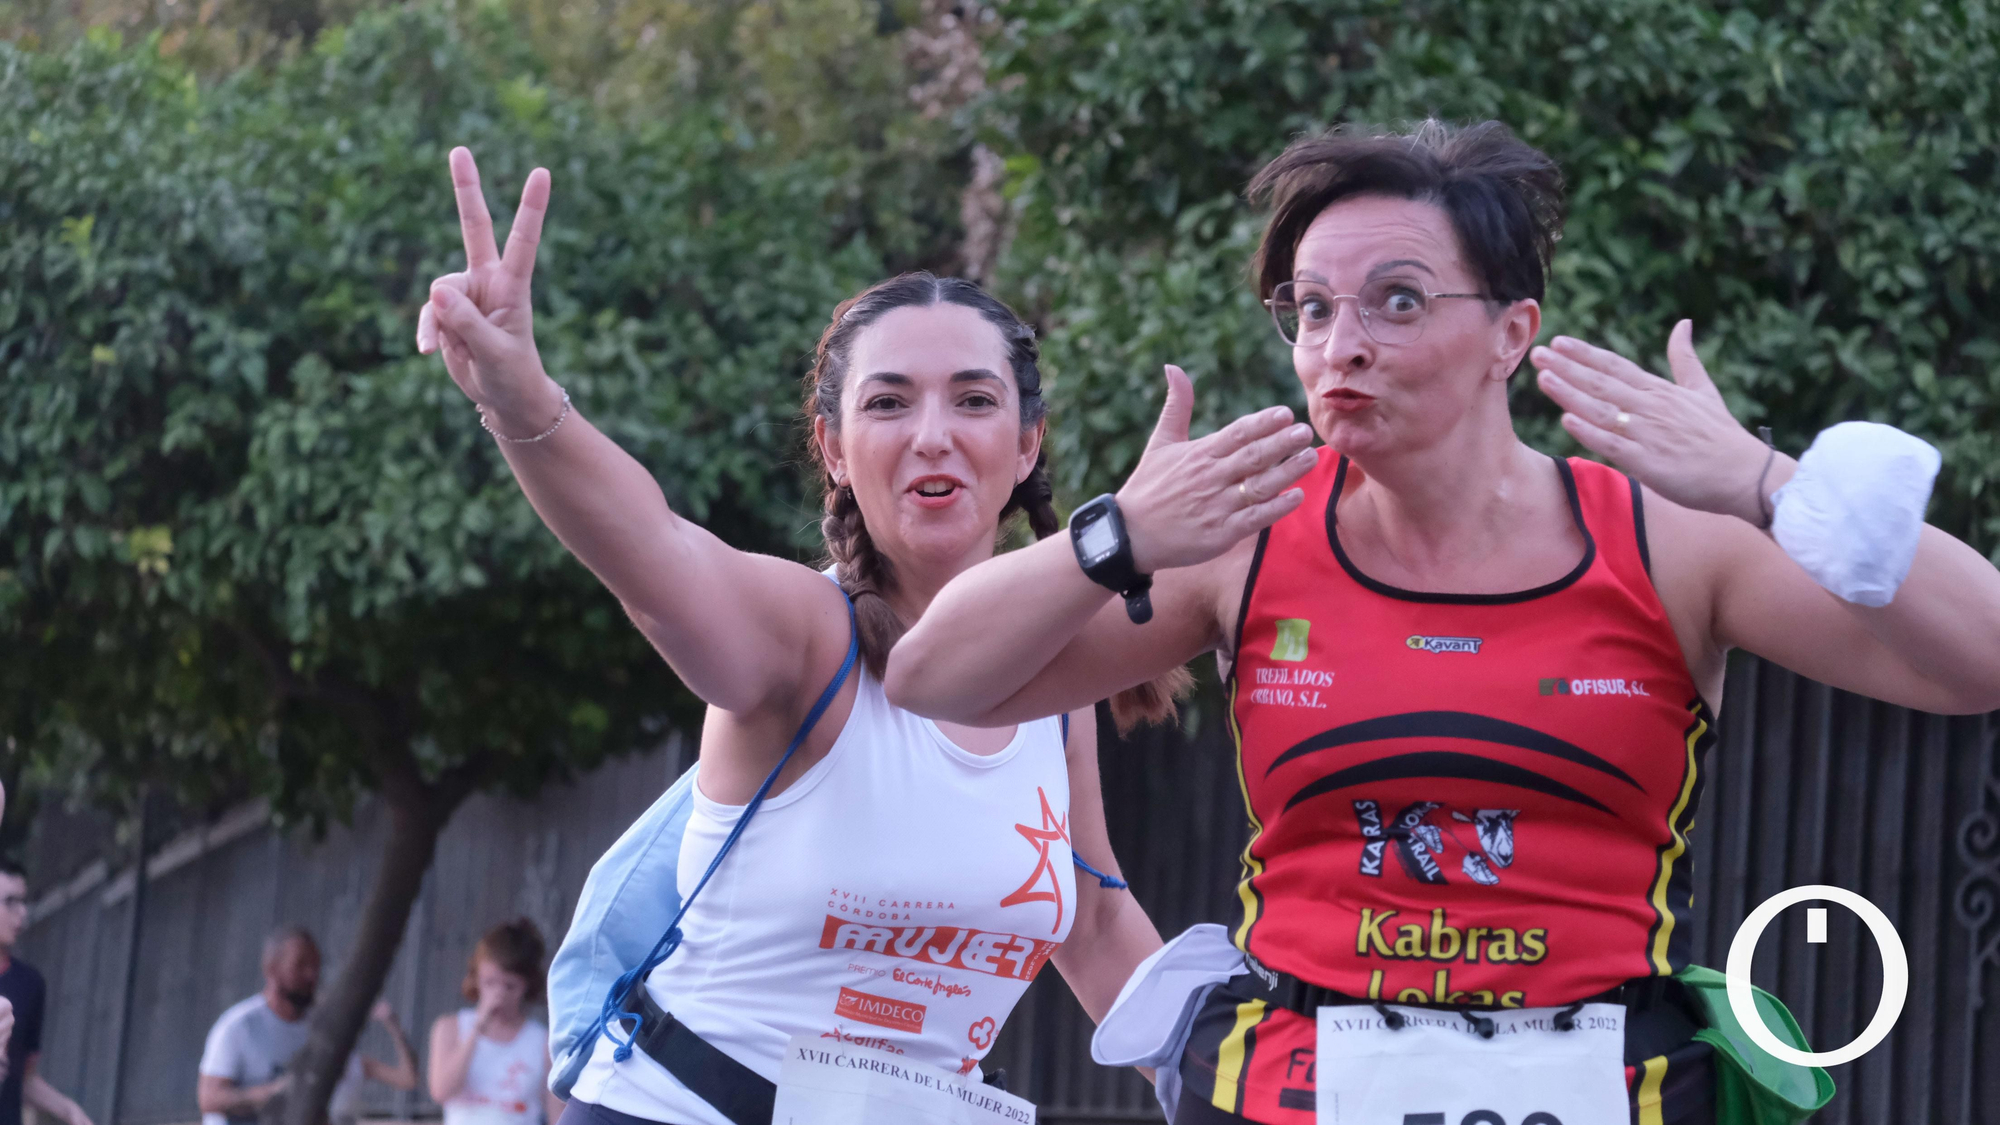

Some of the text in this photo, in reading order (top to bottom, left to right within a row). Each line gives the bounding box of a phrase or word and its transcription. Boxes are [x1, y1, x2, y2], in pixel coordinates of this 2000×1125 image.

[1571, 678, 1632, 698] OFISUR,
[1407, 832, 1440, 881] TRAIL
[827, 900, 911, 920] CÓRDOBA
[830, 887, 955, 910] XVII CARRERA
[1357, 907, 1548, 962] Kabras
[847, 963, 887, 977] PREMIO
[905, 971, 933, 989] Corte
[932, 974, 972, 998] Inglés
[858, 998, 924, 1023] IMDECO
[1332, 1018, 1371, 1032] XVII
[1376, 1014, 1461, 1032] CRRERA
[1588, 1016, 1618, 1032] 2022
[796, 1047, 1031, 1125] XVII CARRERA DE LA MUJER 2022
